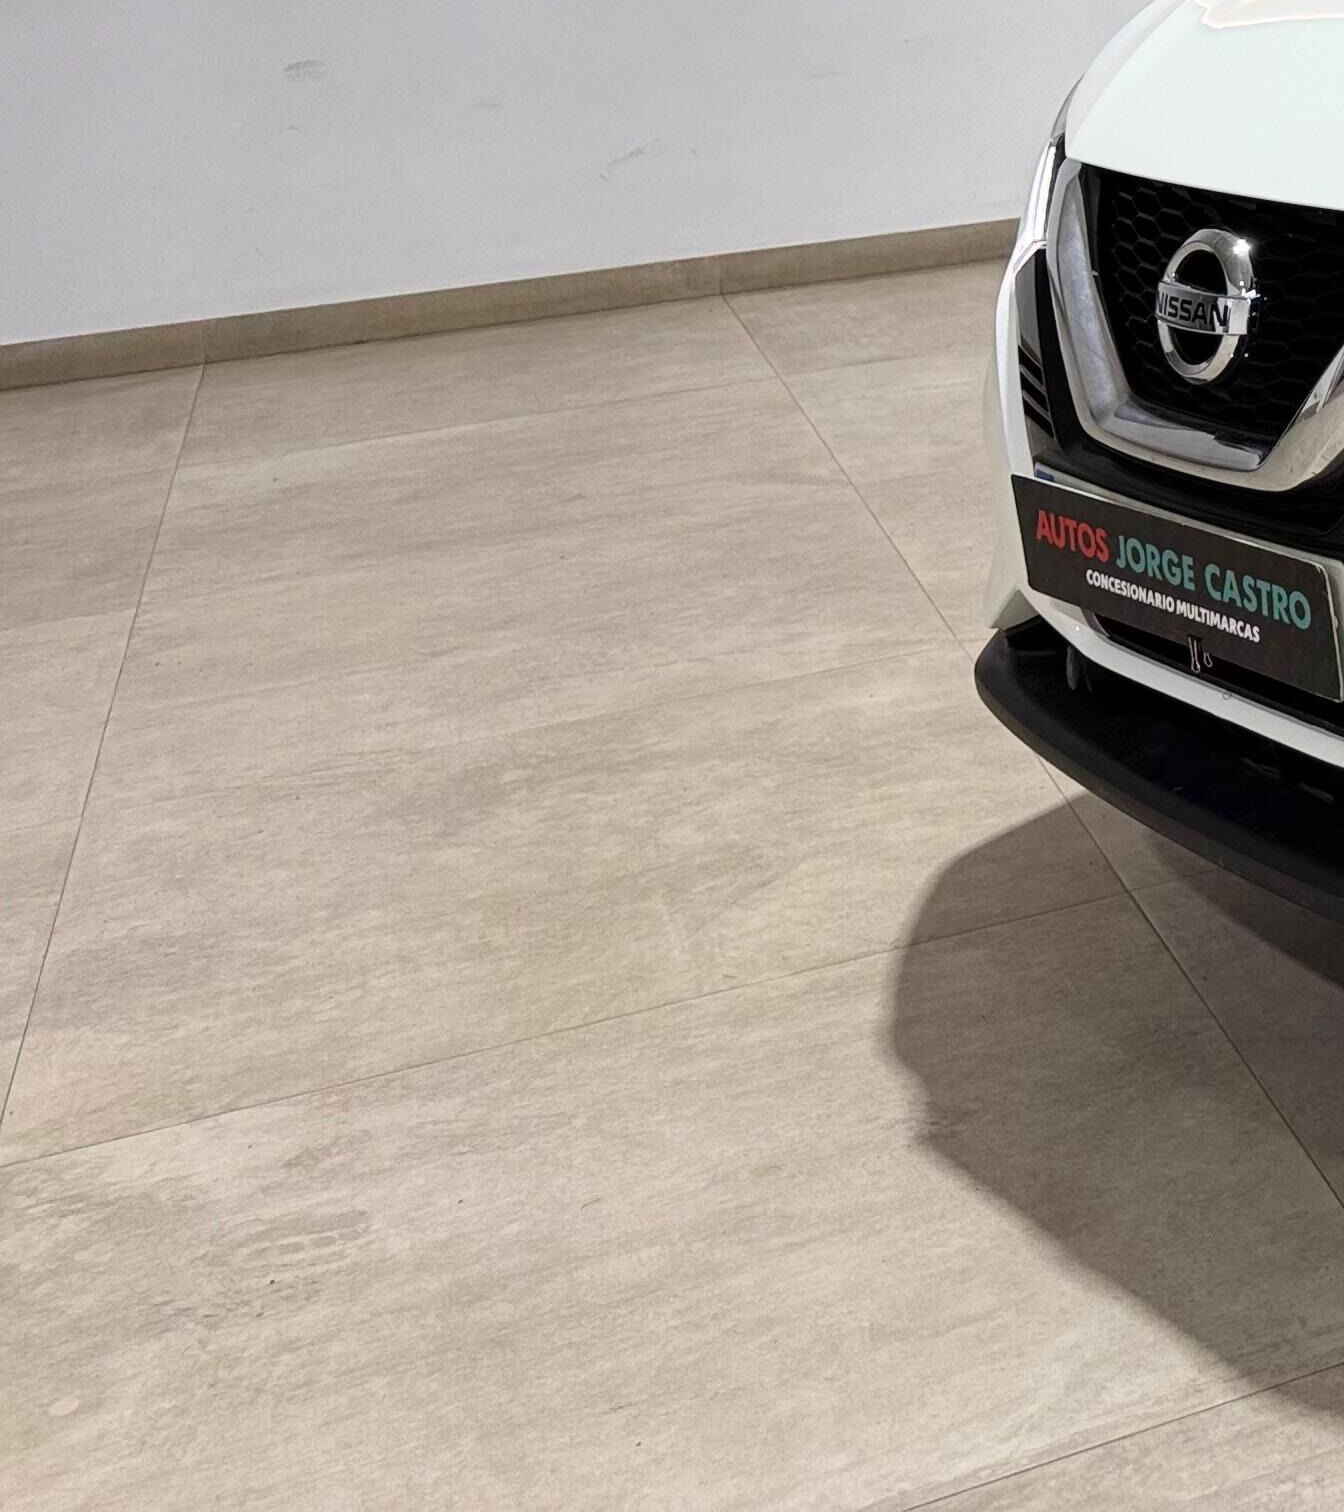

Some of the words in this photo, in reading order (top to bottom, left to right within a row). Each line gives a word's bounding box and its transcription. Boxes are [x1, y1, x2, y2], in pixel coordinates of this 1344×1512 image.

[1157, 291, 1229, 327] NISSAN
[1036, 509, 1110, 563] AUTOS
[1115, 535, 1196, 592] JORGE
[1204, 563, 1312, 631] CASTRO
[1086, 568, 1176, 614] CONCESIONARIO
[1175, 599, 1261, 644] MULTIMARCAS
